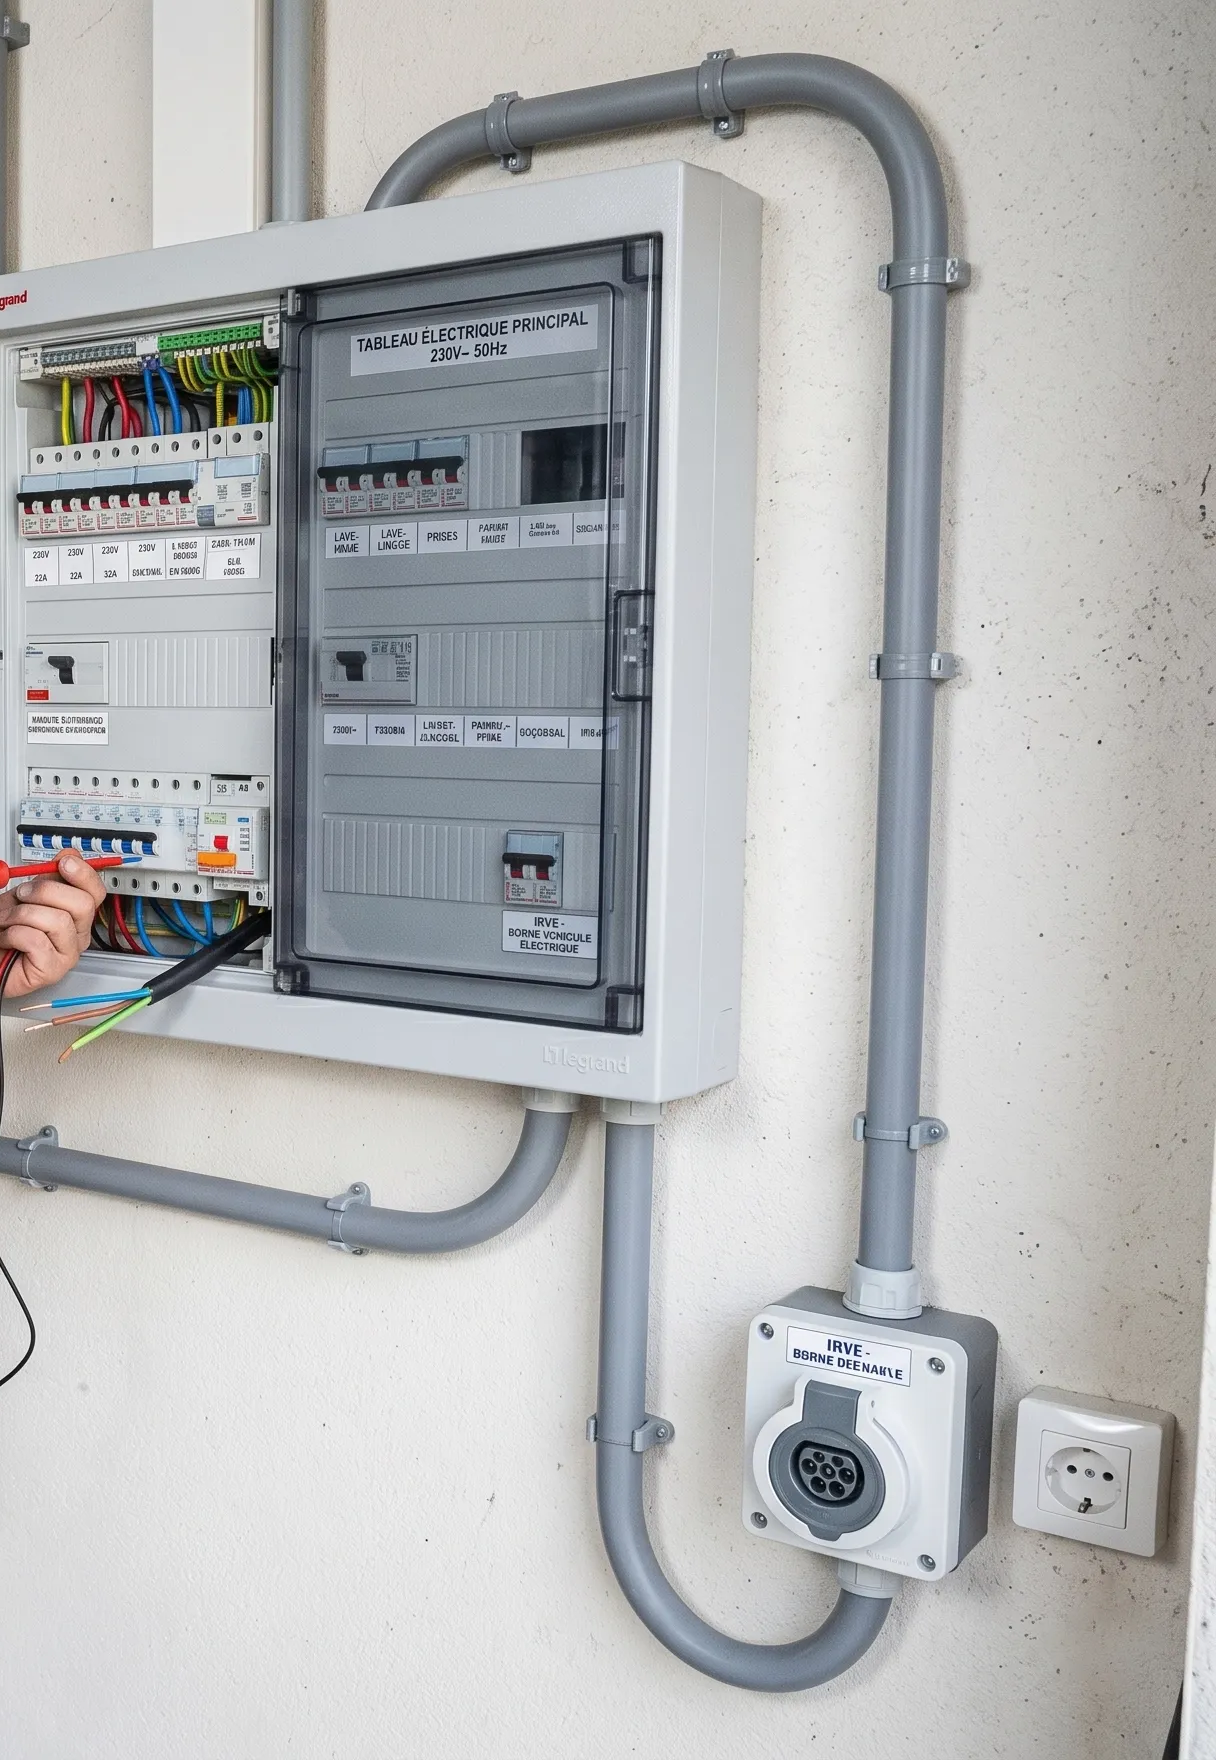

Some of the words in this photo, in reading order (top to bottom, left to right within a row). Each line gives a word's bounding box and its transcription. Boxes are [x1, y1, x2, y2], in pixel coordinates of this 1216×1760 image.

[357, 332, 418, 352] TABLEAU
[422, 320, 508, 344] ÉLECTRIQUE
[512, 311, 589, 334] PRINCIPAL
[474, 341, 508, 358] 50Hz
[334, 531, 359, 542] LAVE-
[381, 528, 407, 539] LAVE-
[427, 531, 458, 542] PRISES
[67, 548, 85, 557] 230V
[139, 543, 156, 553] 230V
[534, 916, 559, 928] IRVE
[508, 928, 541, 939] BORNE
[827, 1339, 863, 1358] IRVE
